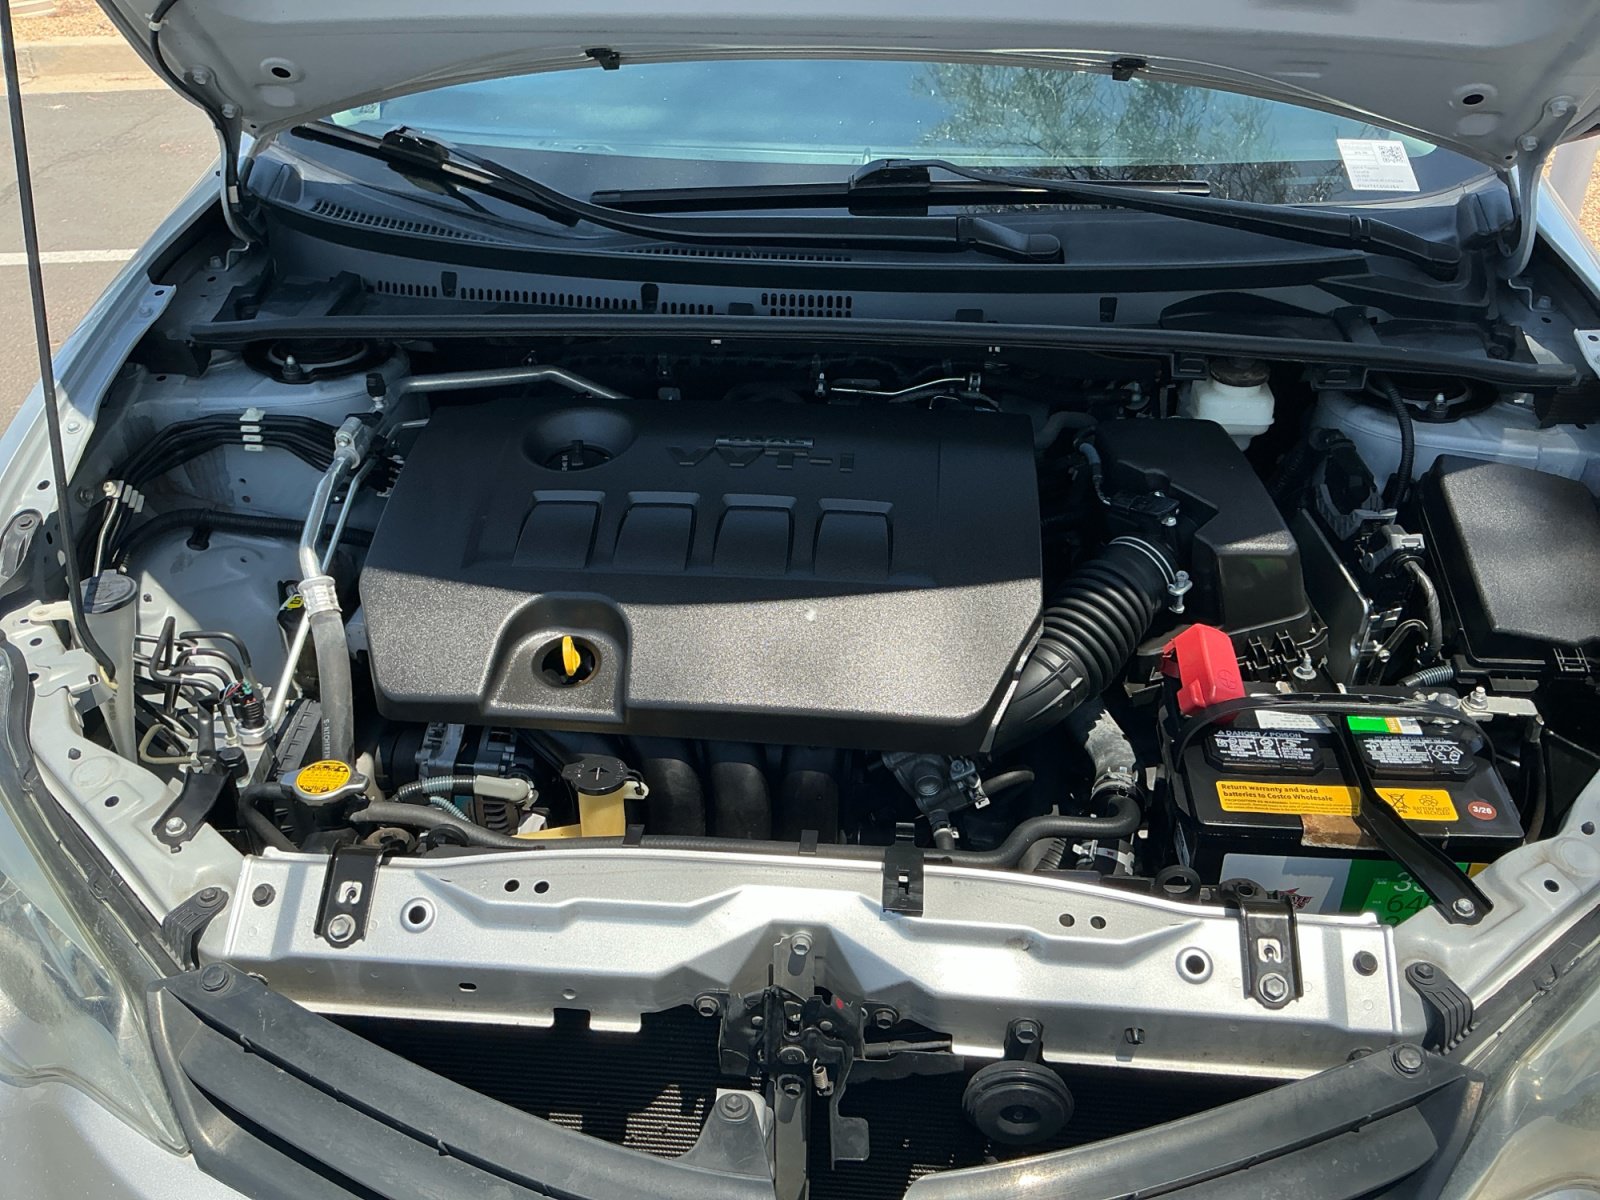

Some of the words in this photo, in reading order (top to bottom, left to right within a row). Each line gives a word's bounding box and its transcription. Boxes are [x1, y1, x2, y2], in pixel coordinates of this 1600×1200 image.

[1249, 785, 1282, 793] warranty
[1267, 792, 1292, 800] Costco
[1294, 793, 1333, 801] Wholesale
